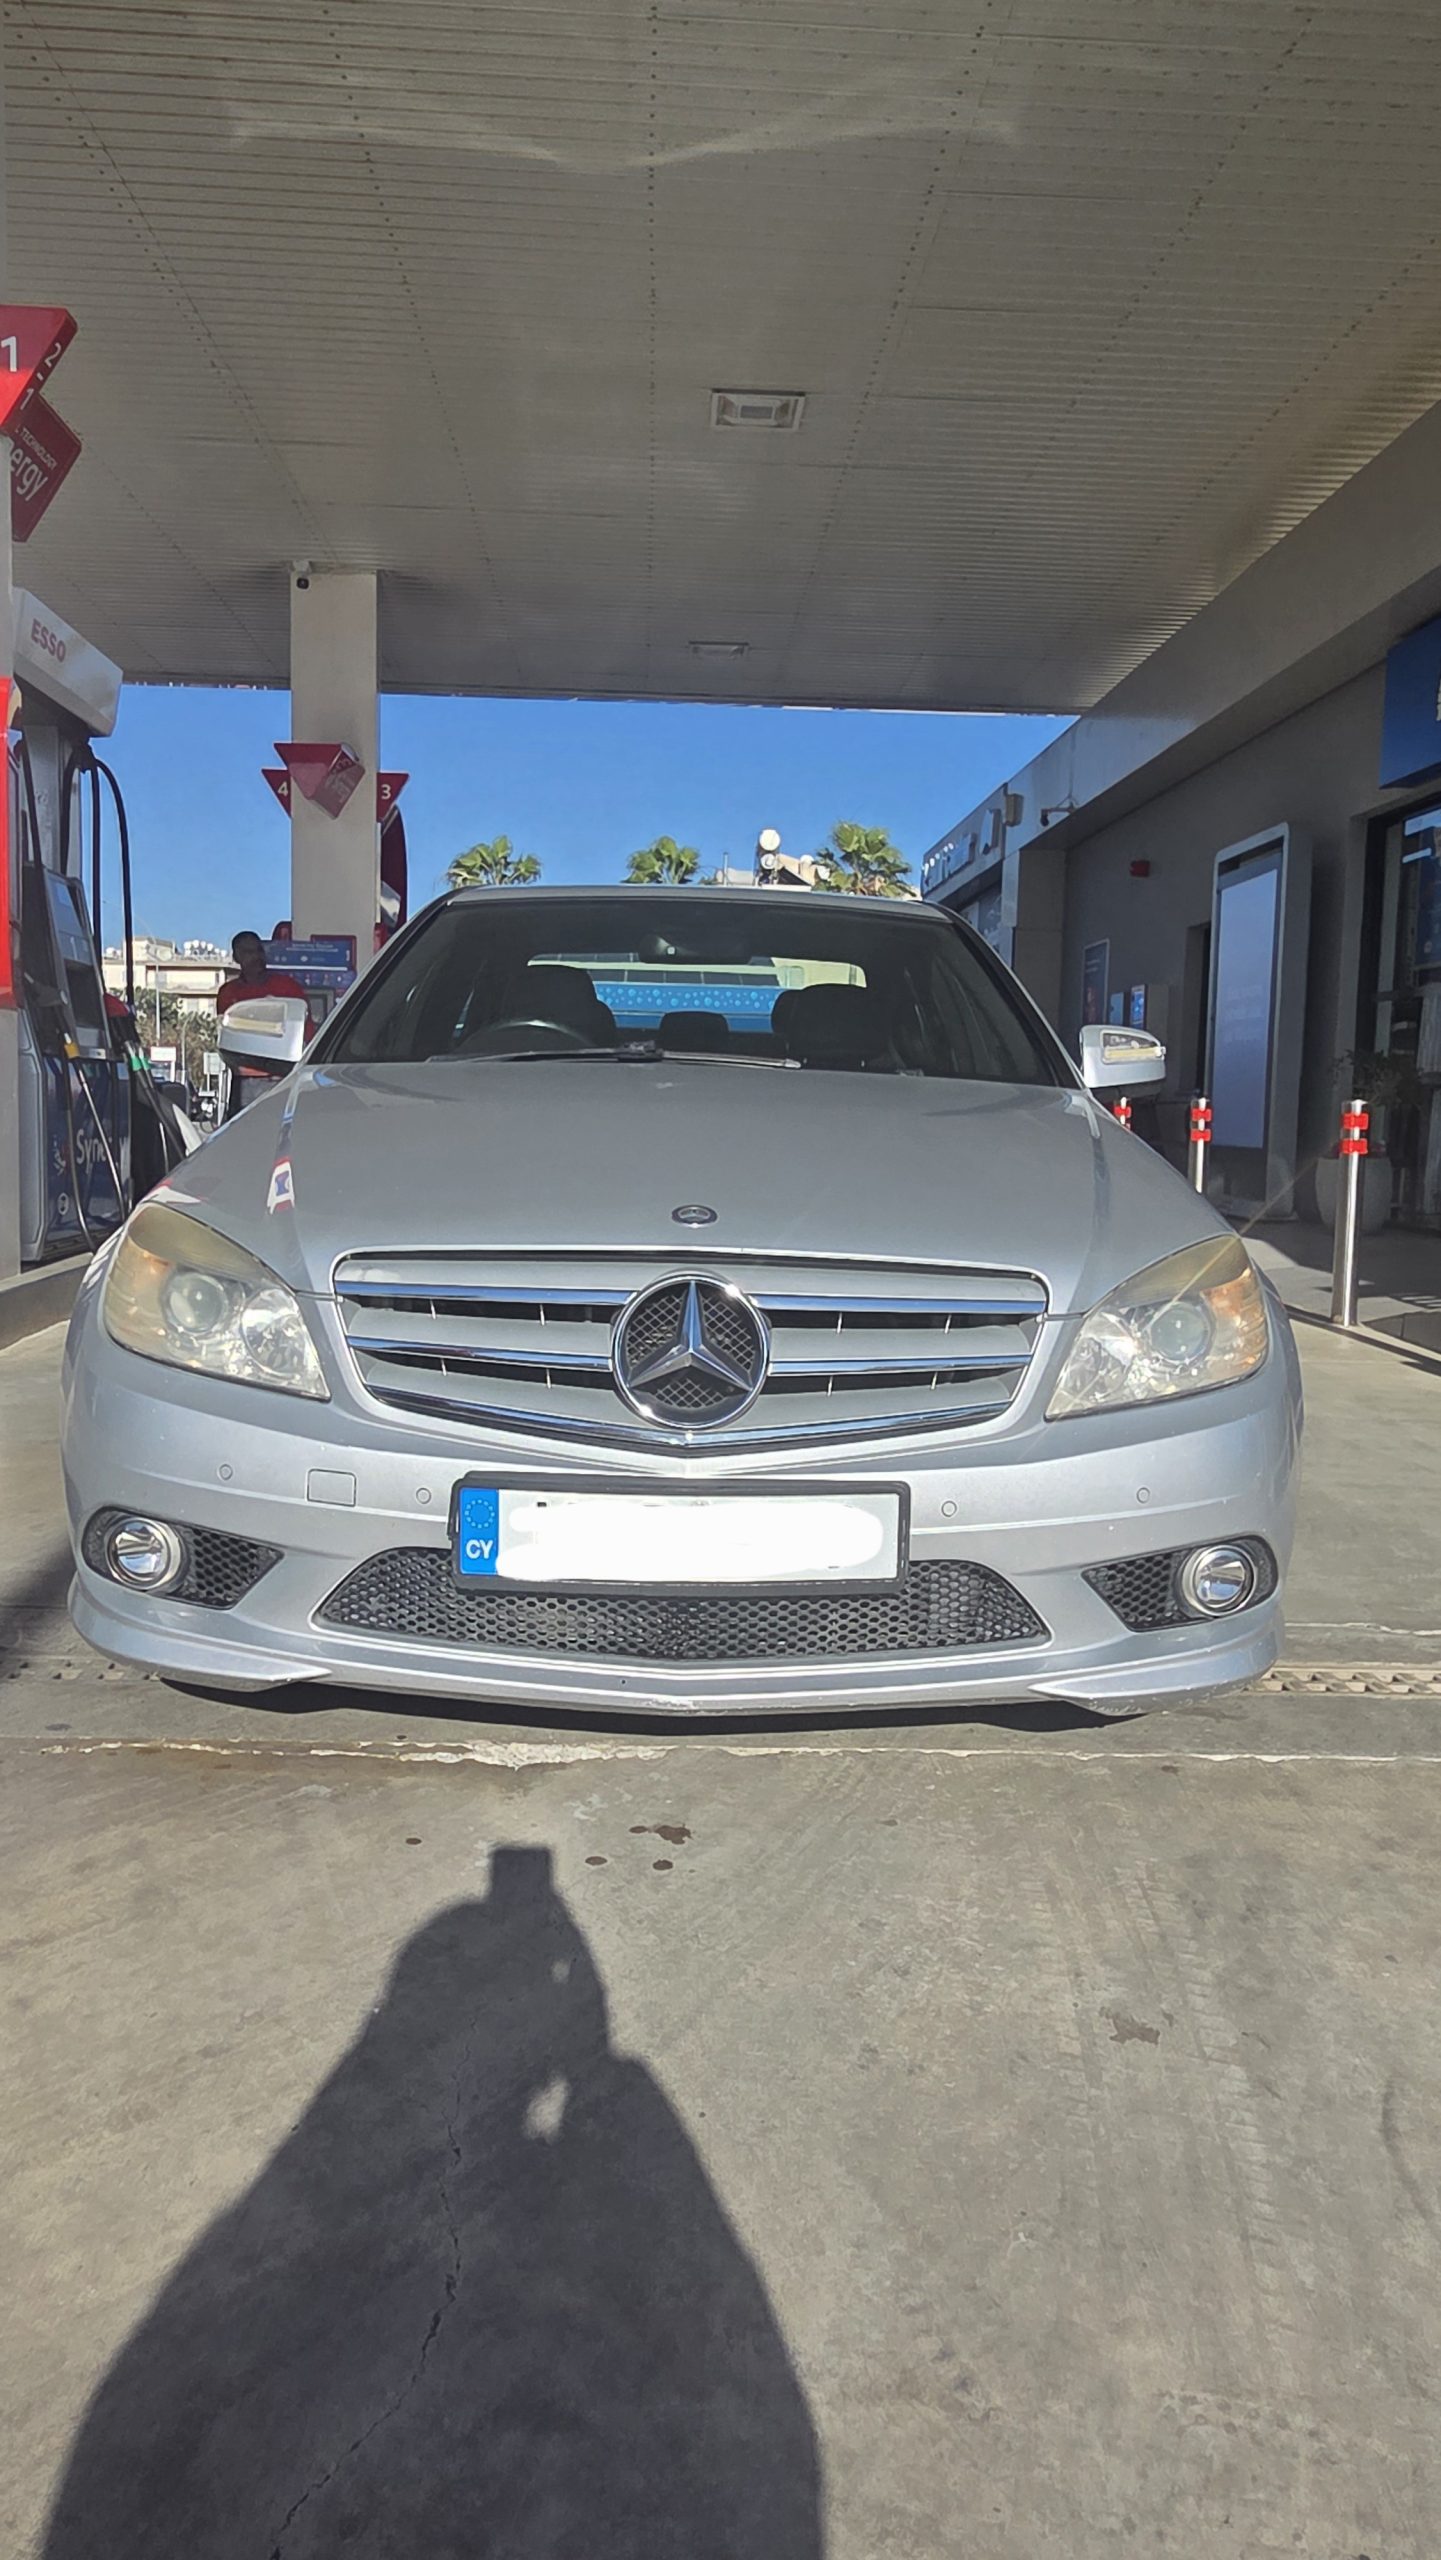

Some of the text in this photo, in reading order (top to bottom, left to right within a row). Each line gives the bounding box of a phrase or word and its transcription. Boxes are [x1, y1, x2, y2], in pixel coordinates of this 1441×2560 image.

[1, 335, 18, 373] 1
[44, 342, 62, 367] 2
[9, 445, 48, 502] ergy
[31, 618, 66, 663] ESSO
[277, 781, 289, 797] 4
[380, 784, 392, 800] 3
[465, 1538, 494, 1560] CY
